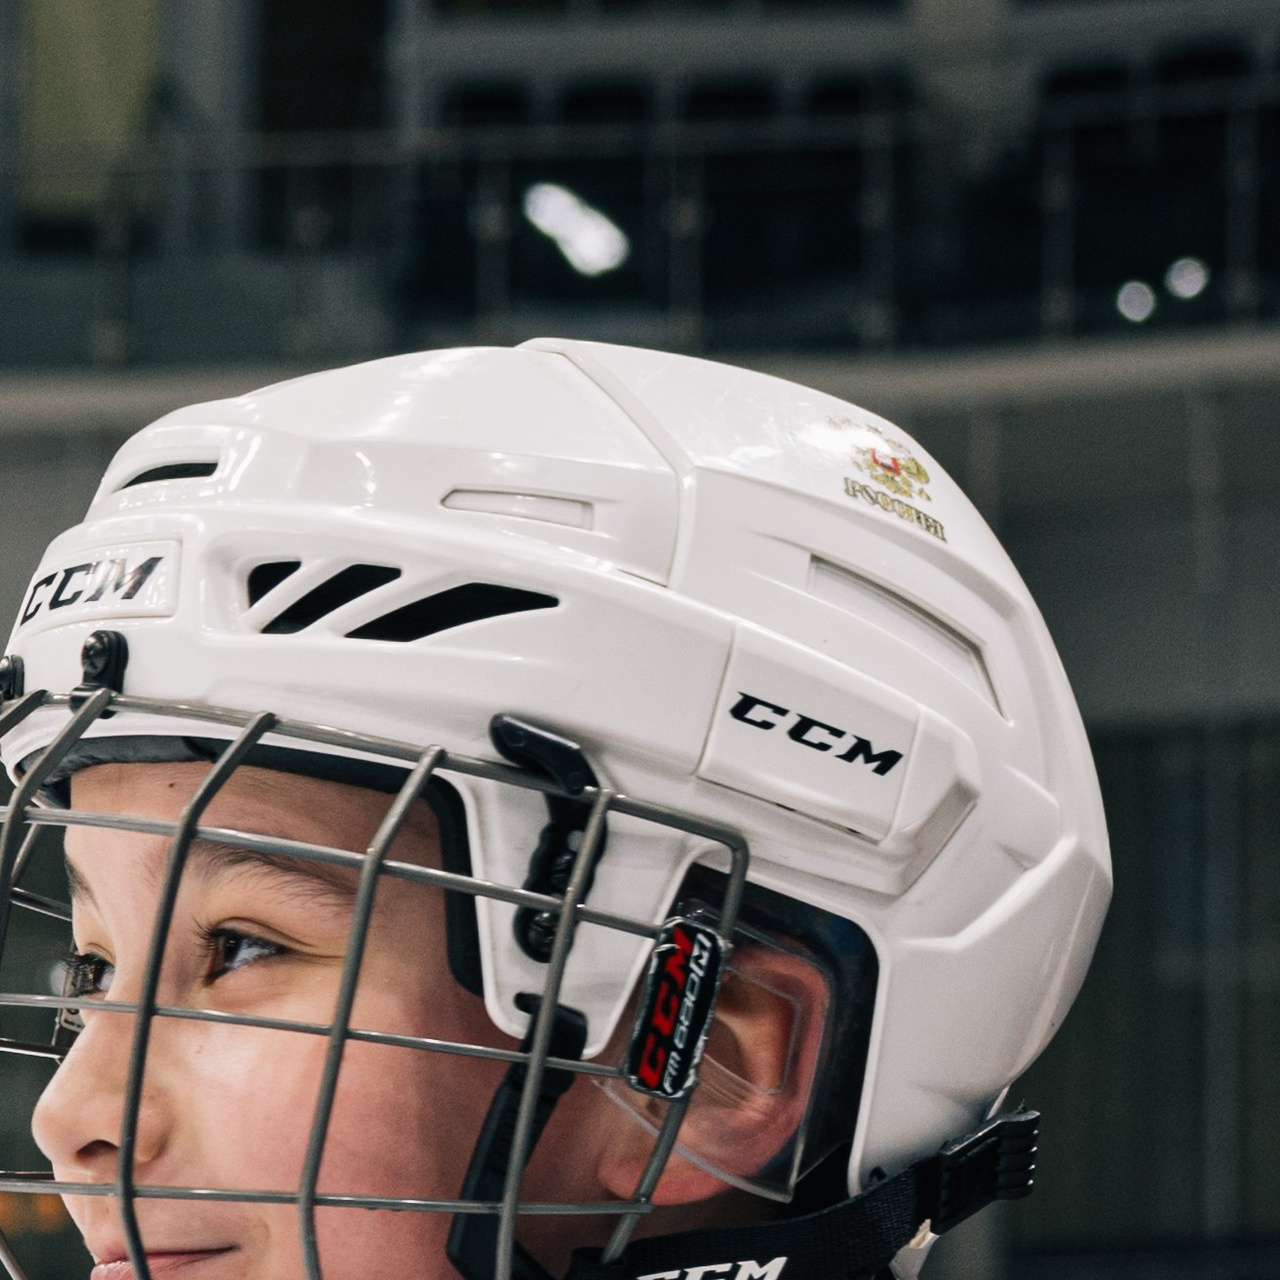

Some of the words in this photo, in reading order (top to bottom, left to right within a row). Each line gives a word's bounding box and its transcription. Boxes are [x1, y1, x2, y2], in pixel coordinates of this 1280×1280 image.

[19, 556, 164, 626] CCM
[729, 691, 904, 776] CCM
[638, 926, 693, 1088] CCM
